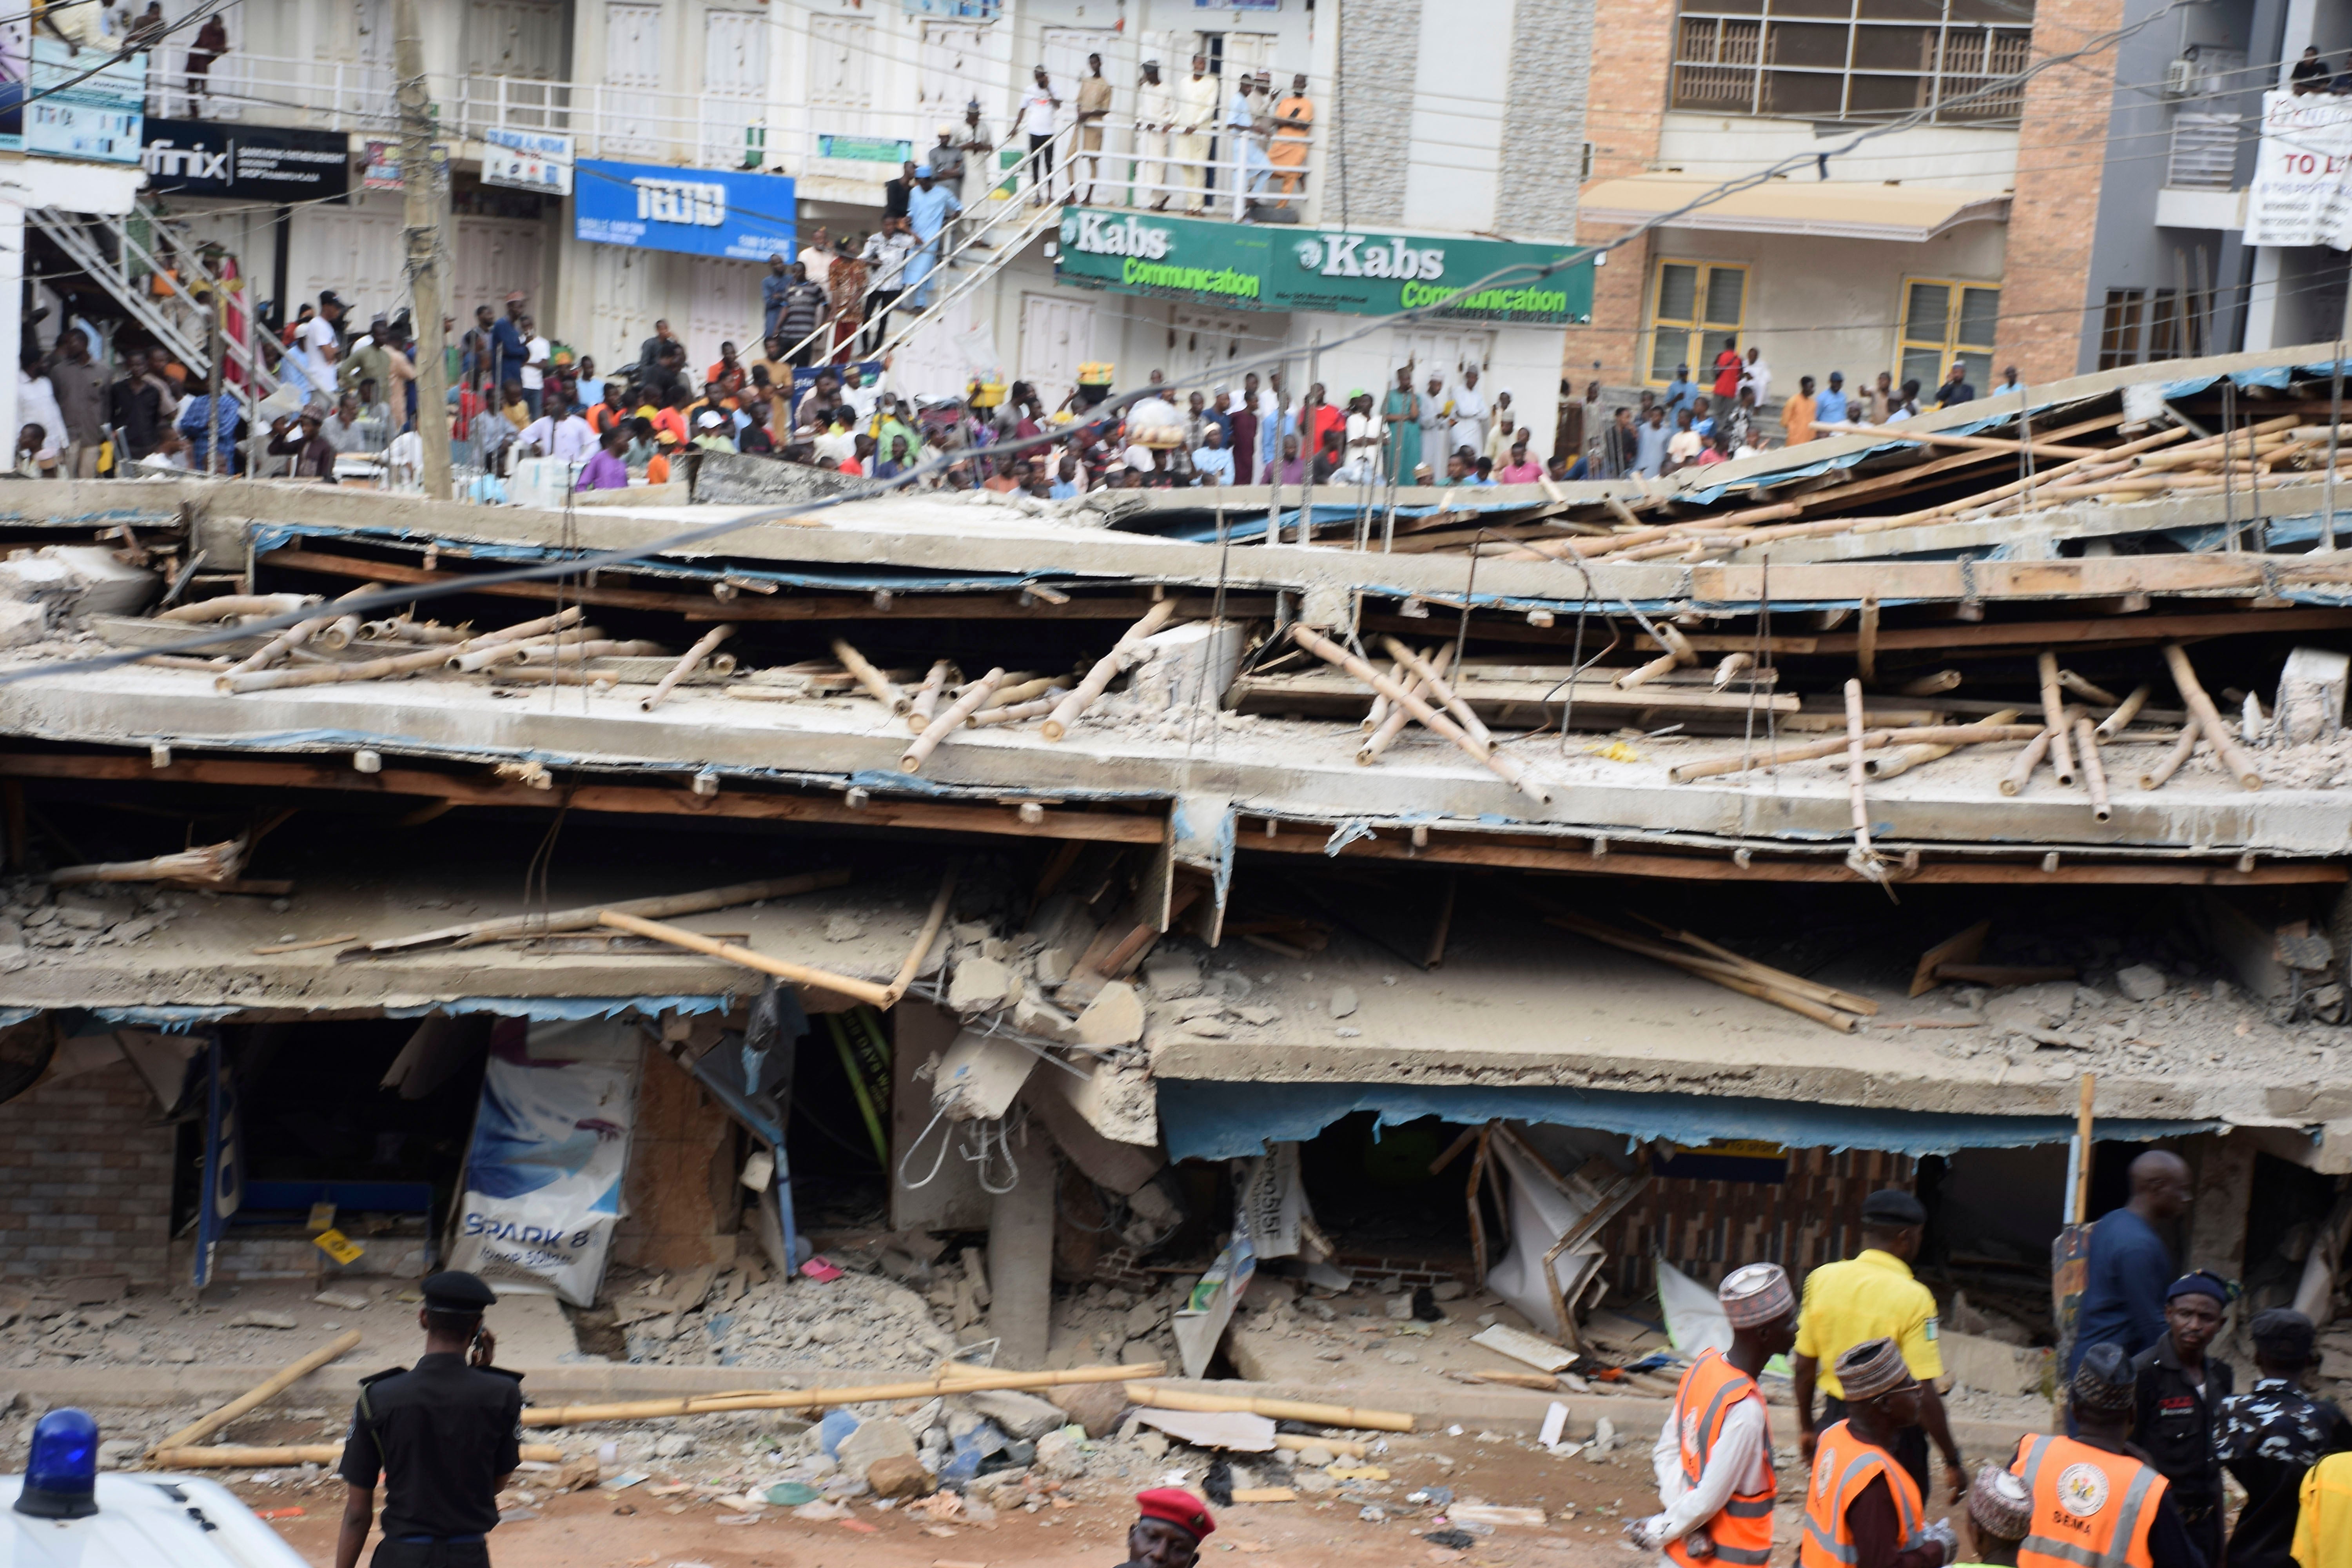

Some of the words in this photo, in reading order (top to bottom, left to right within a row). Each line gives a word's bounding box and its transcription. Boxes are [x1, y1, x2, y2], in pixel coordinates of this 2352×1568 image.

[2284, 154, 2315, 174] TO
[1074, 210, 1169, 260] Kabs
[1321, 235, 1445, 281] Kabs
[1122, 257, 1261, 298] Communication
[855, 1036, 884, 1074] DAYS
[464, 1212, 564, 1248] SPARK
[569, 1230, 590, 1248] 8
[2053, 1510, 2092, 1536] SEMA
